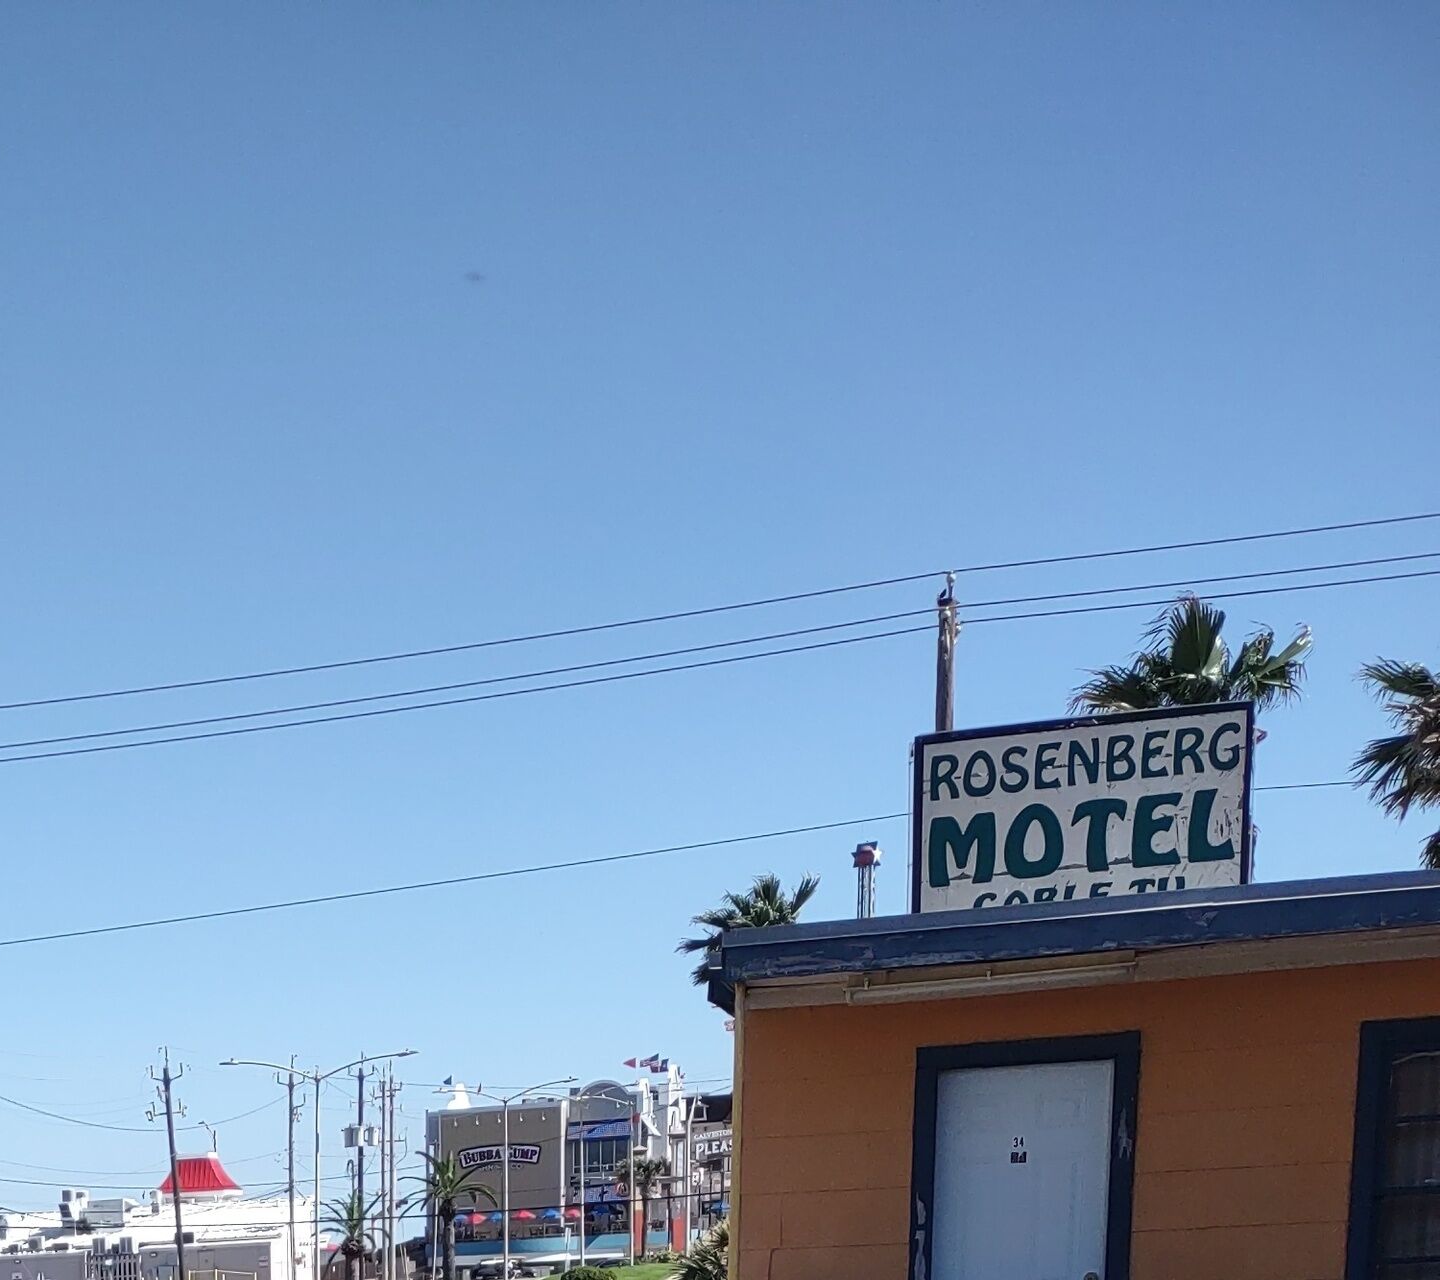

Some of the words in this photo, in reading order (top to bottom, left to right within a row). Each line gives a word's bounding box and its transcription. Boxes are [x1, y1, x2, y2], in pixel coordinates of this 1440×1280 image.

[929, 722, 1242, 801] ROSENBERG
[928, 788, 1236, 888] MOTEL
[463, 1148, 502, 1165] BUBBA
[1013, 1136, 1024, 1148] 34
